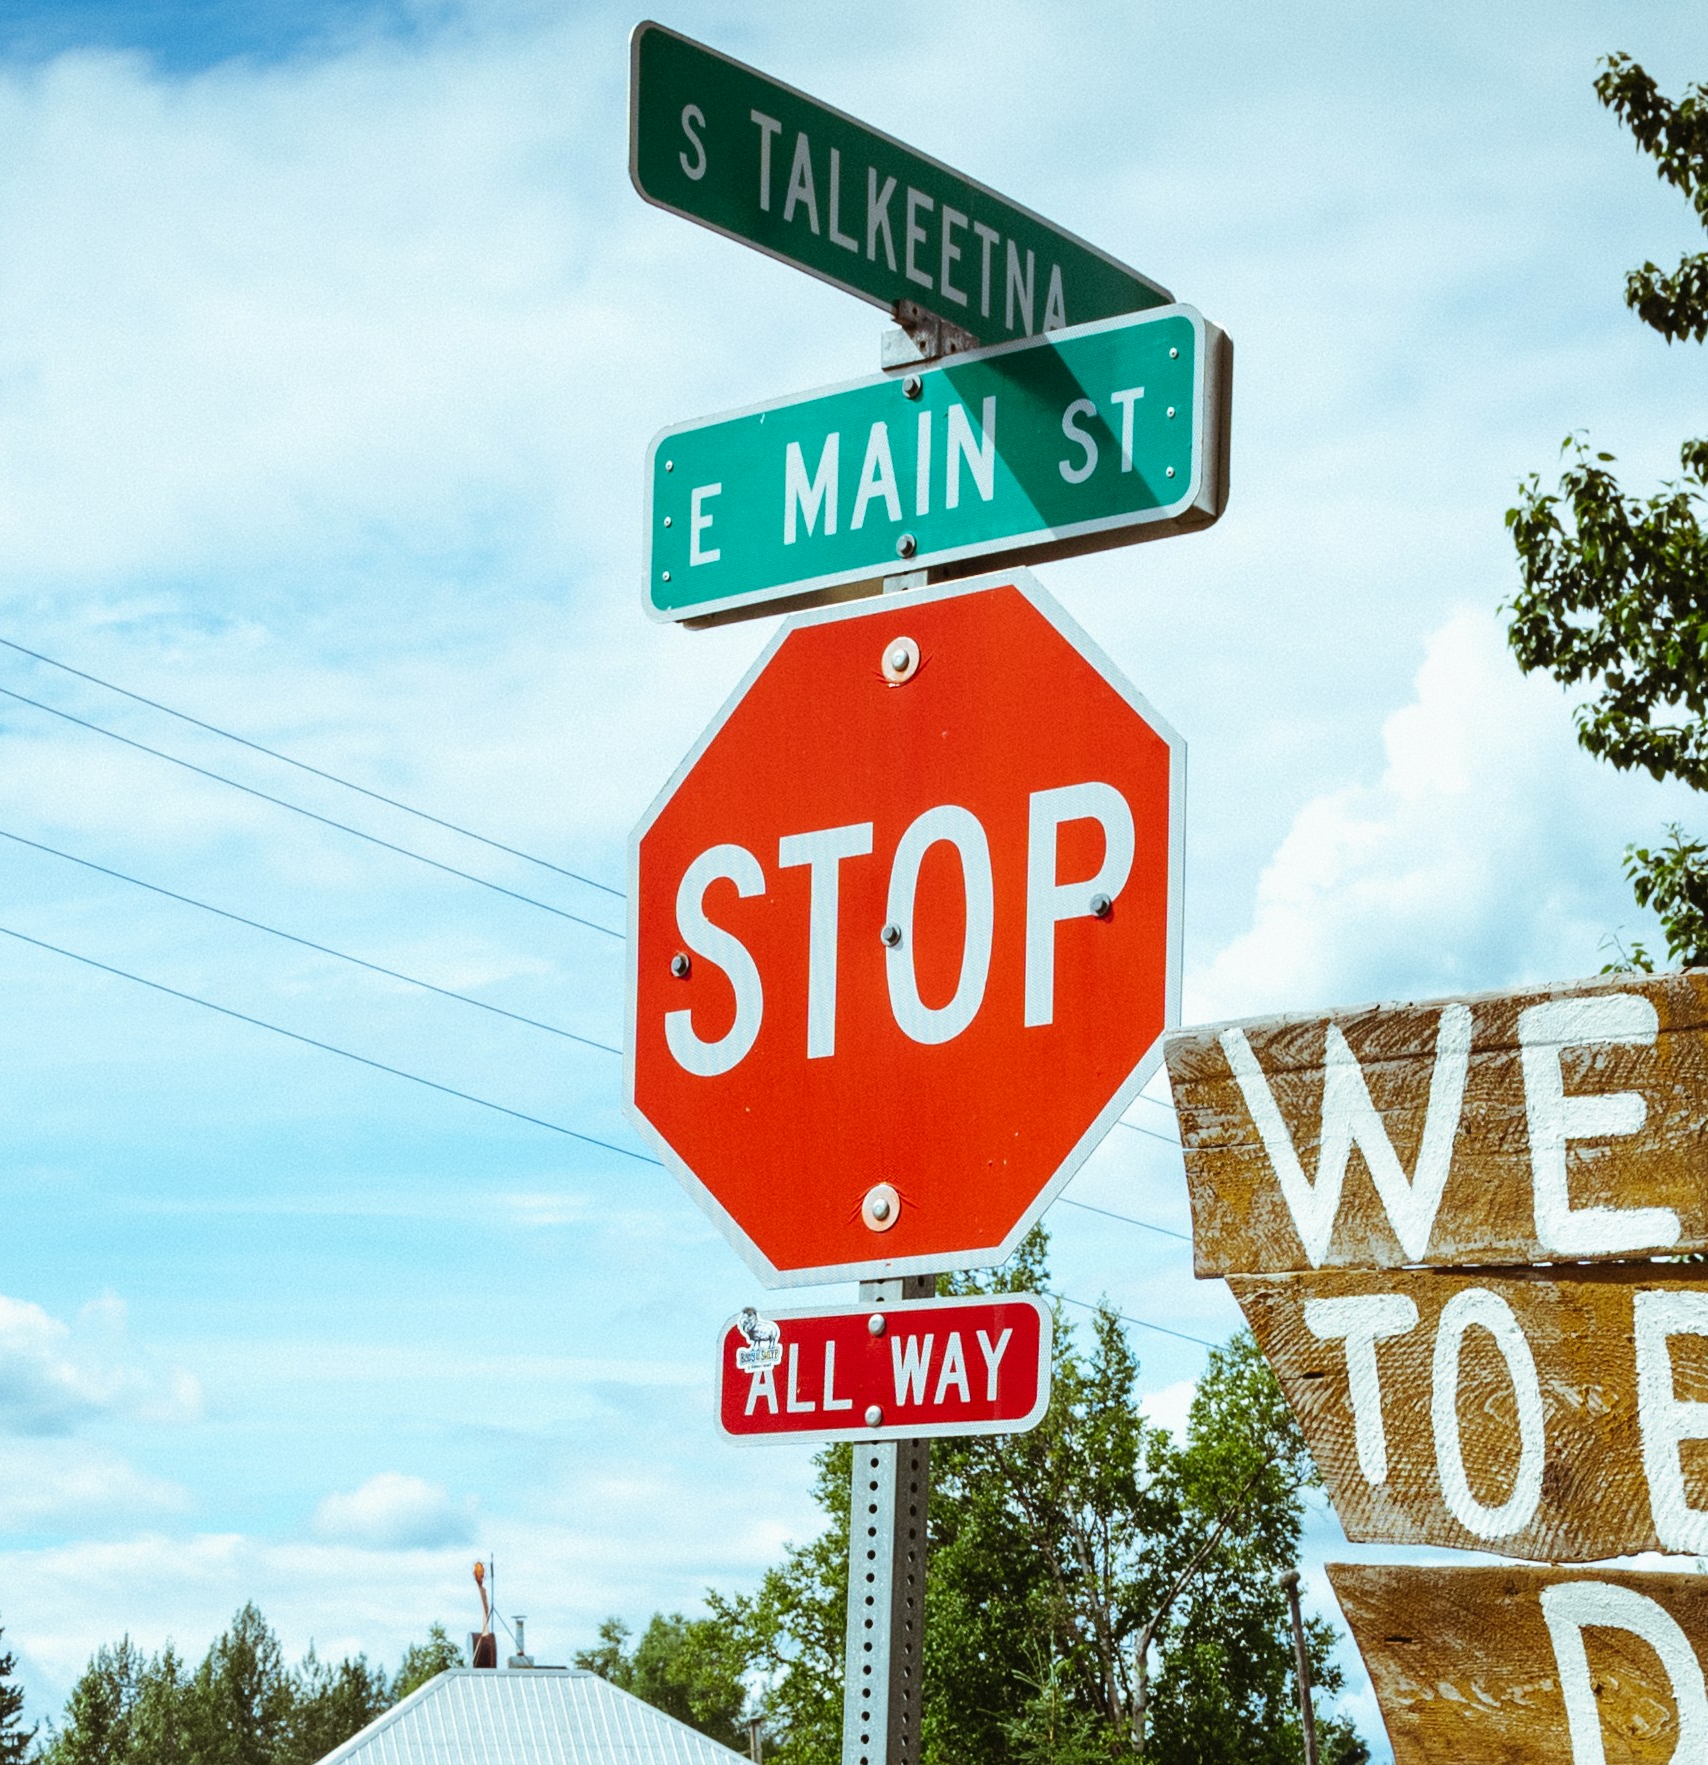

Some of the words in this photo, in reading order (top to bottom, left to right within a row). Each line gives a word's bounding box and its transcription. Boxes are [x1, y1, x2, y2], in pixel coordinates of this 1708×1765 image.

[679, 104, 707, 181] S
[750, 110, 1068, 338] TALKEETNA
[689, 482, 722, 566] E
[783, 396, 997, 545] MAIN
[1058, 387, 1145, 485] ST
[664, 781, 1136, 1077] STOP
[743, 1340, 854, 1417] ALL
[891, 1327, 1014, 1407] WAY
[1303, 1285, 1544, 1540] TO
